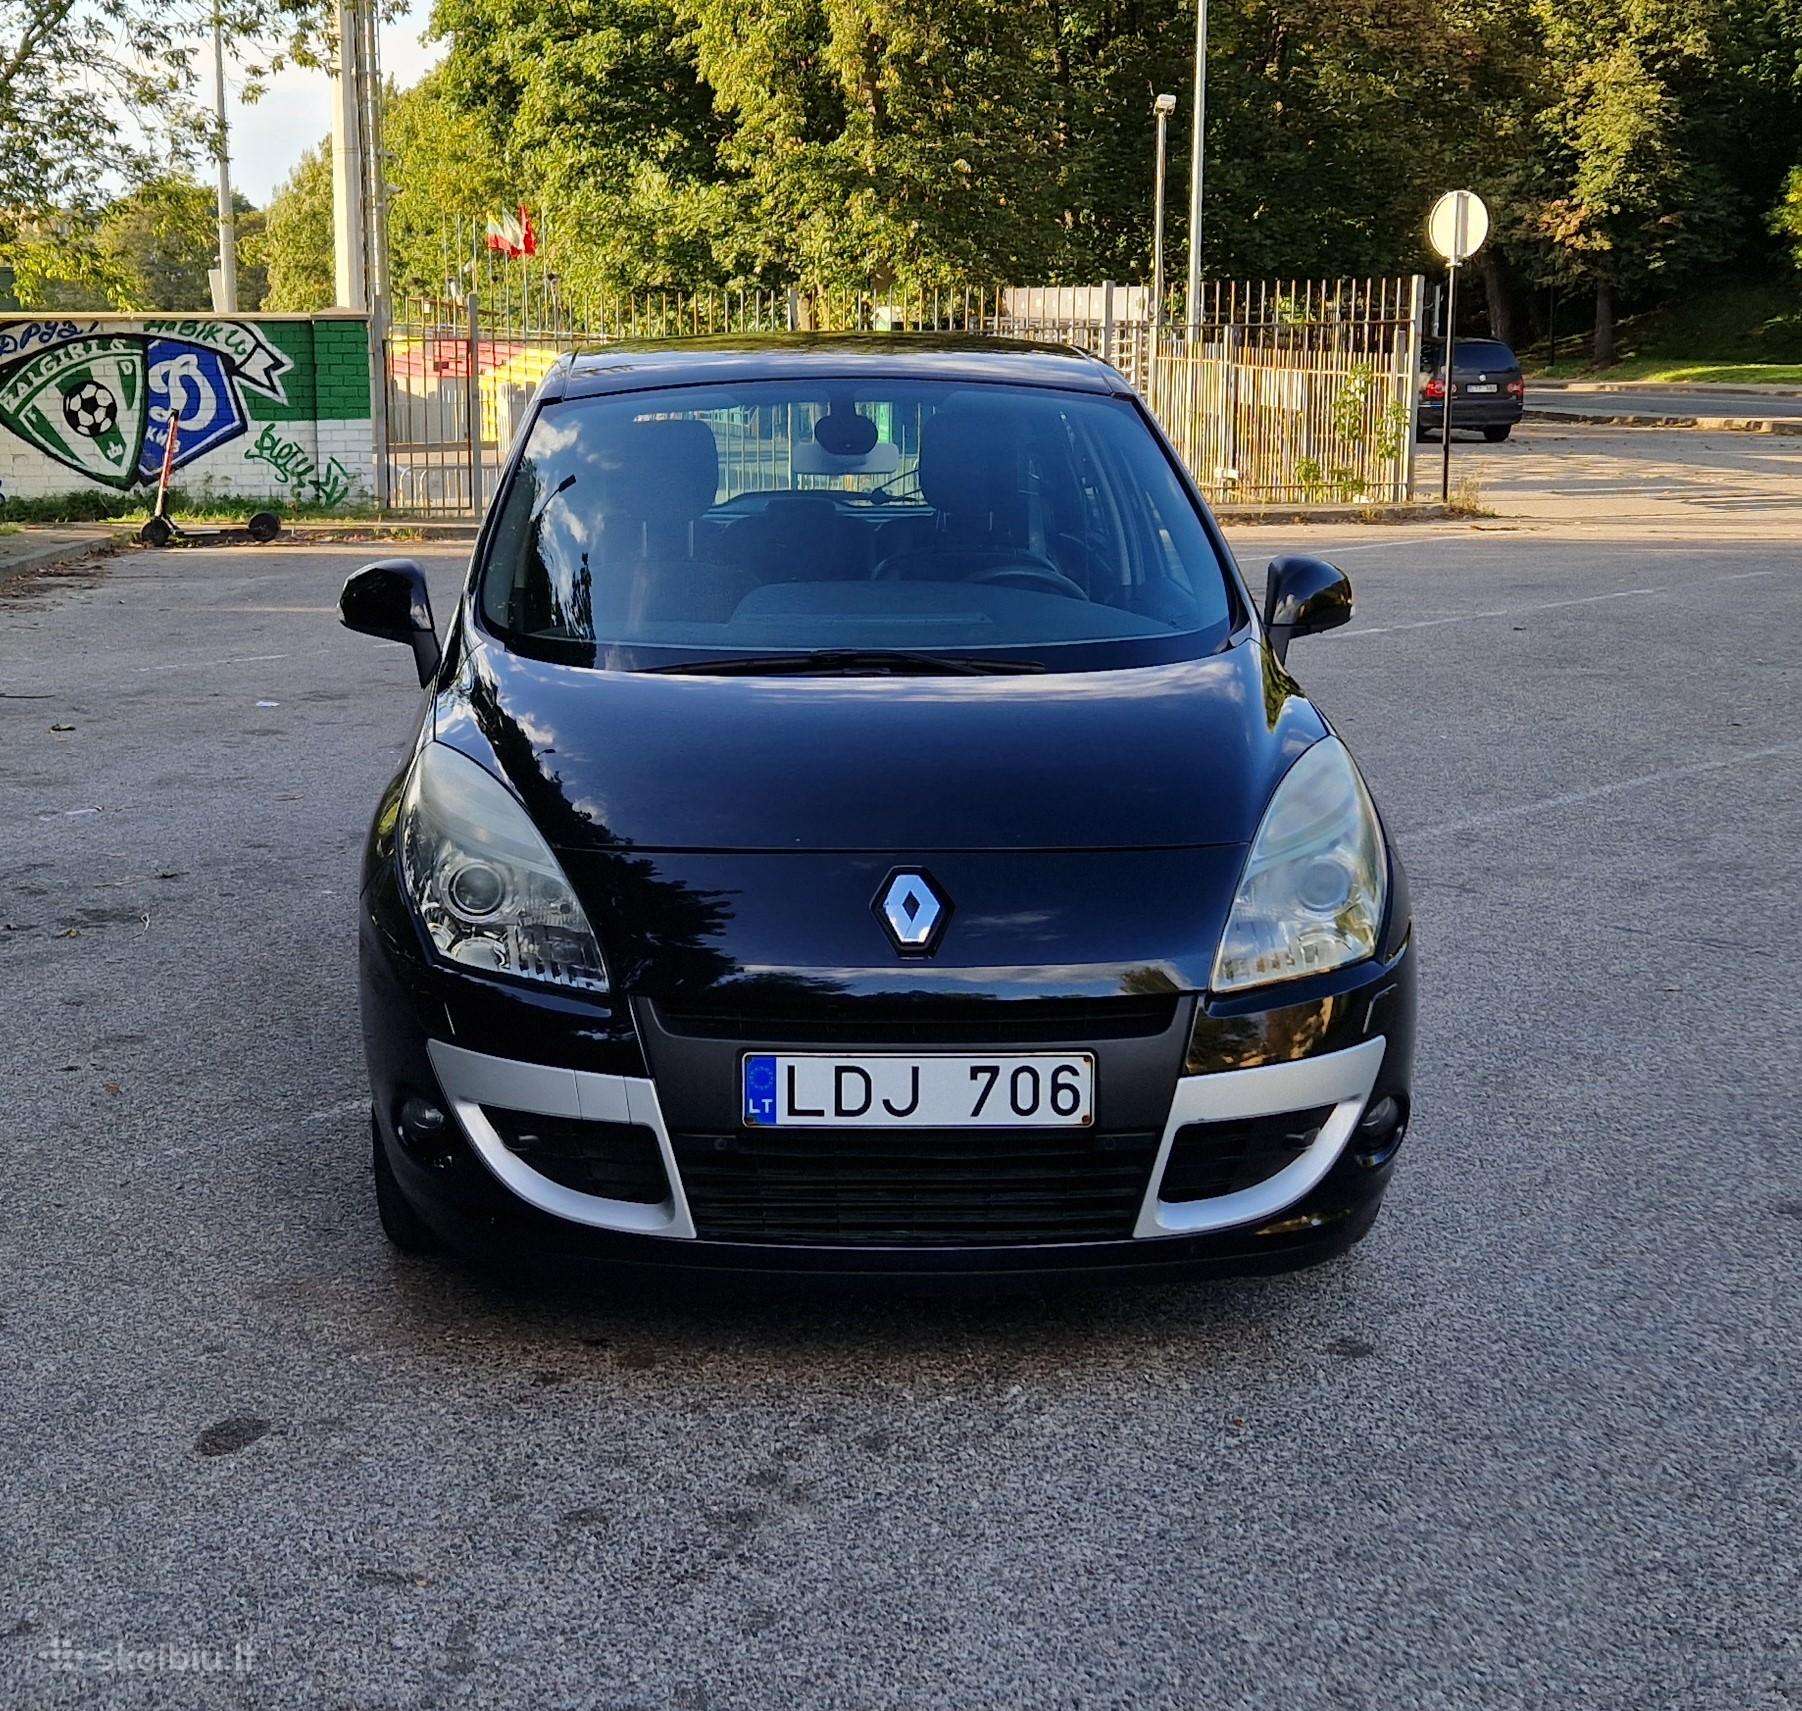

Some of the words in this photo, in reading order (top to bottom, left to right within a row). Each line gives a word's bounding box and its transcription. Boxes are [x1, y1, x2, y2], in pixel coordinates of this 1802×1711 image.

[748, 1098, 773, 1114] LT
[787, 1065, 920, 1118] LDJ
[969, 1064, 1081, 1118] 706
